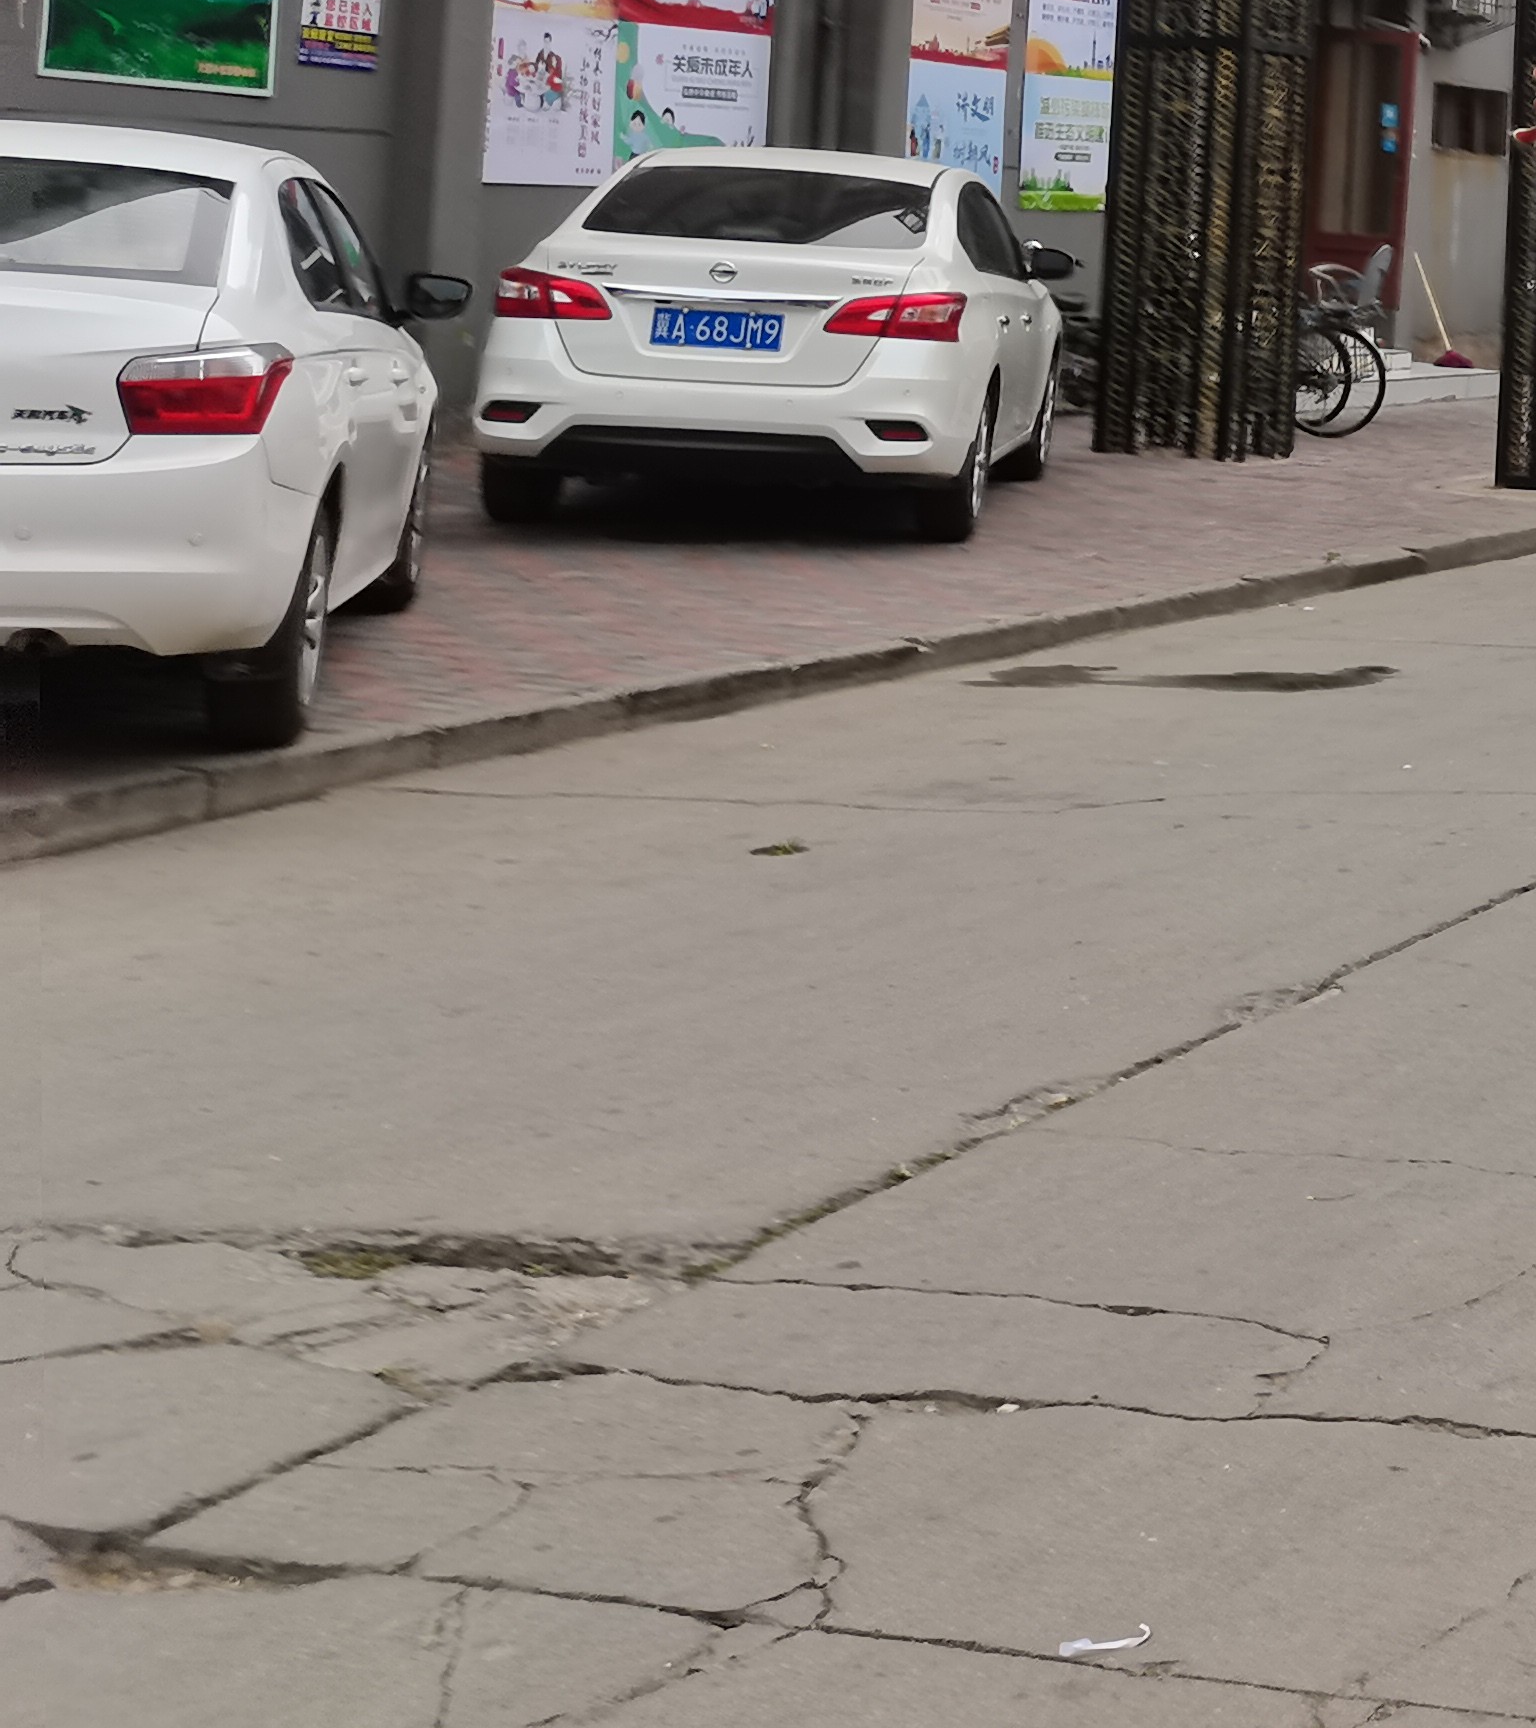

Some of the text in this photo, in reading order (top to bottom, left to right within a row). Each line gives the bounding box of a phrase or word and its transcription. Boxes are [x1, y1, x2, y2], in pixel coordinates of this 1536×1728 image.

[673, 54, 753, 78] 关爱未成年人
